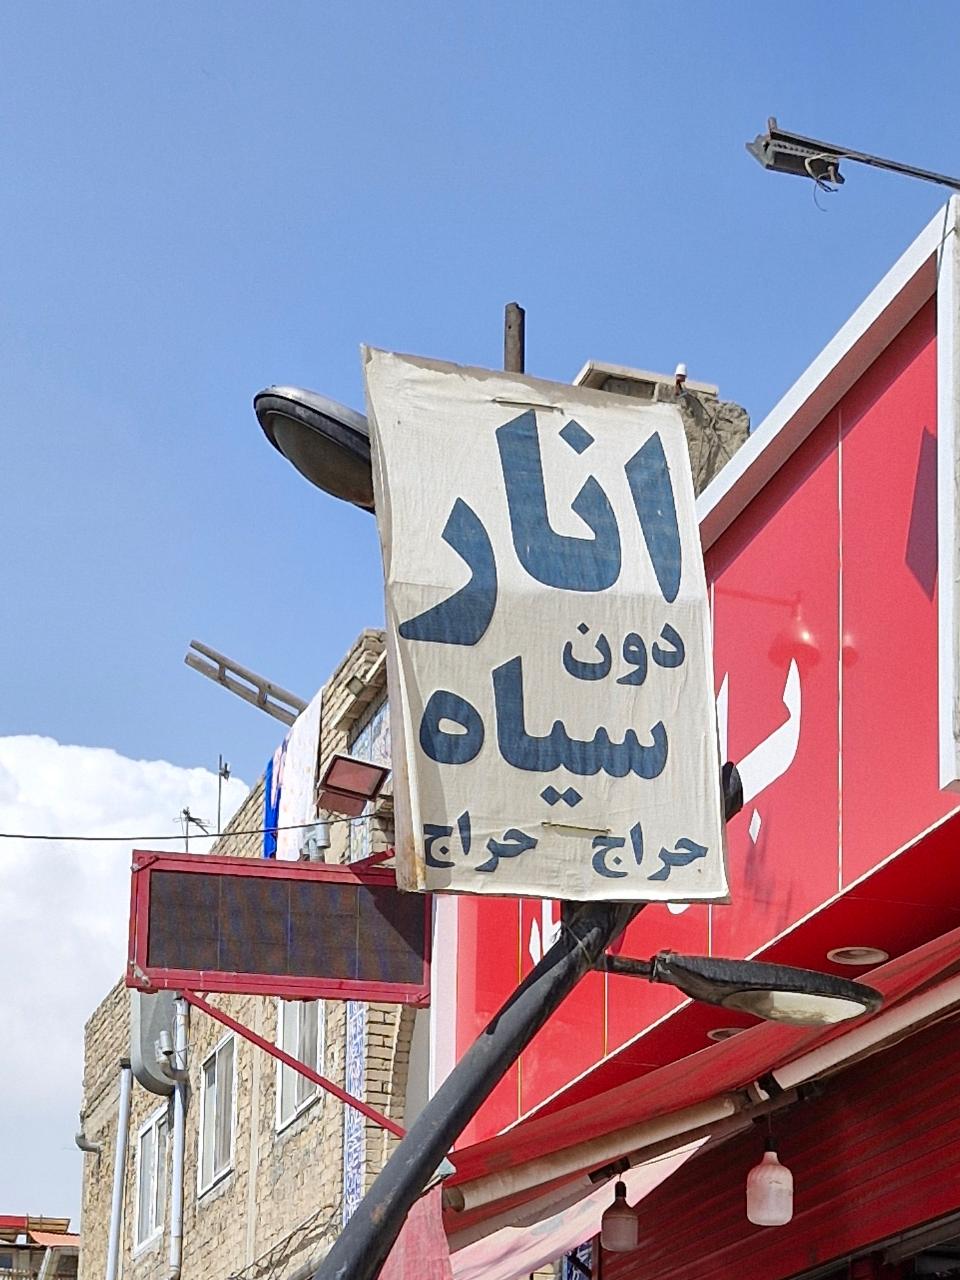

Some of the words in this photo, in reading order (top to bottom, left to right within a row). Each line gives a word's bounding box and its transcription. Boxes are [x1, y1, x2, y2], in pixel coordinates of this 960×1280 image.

[399, 409, 682, 646] انار
[563, 622, 685, 686] دون
[419, 655, 668, 808] سیاه
[423, 811, 538, 872] حراج
[591, 823, 708, 880] حراج
